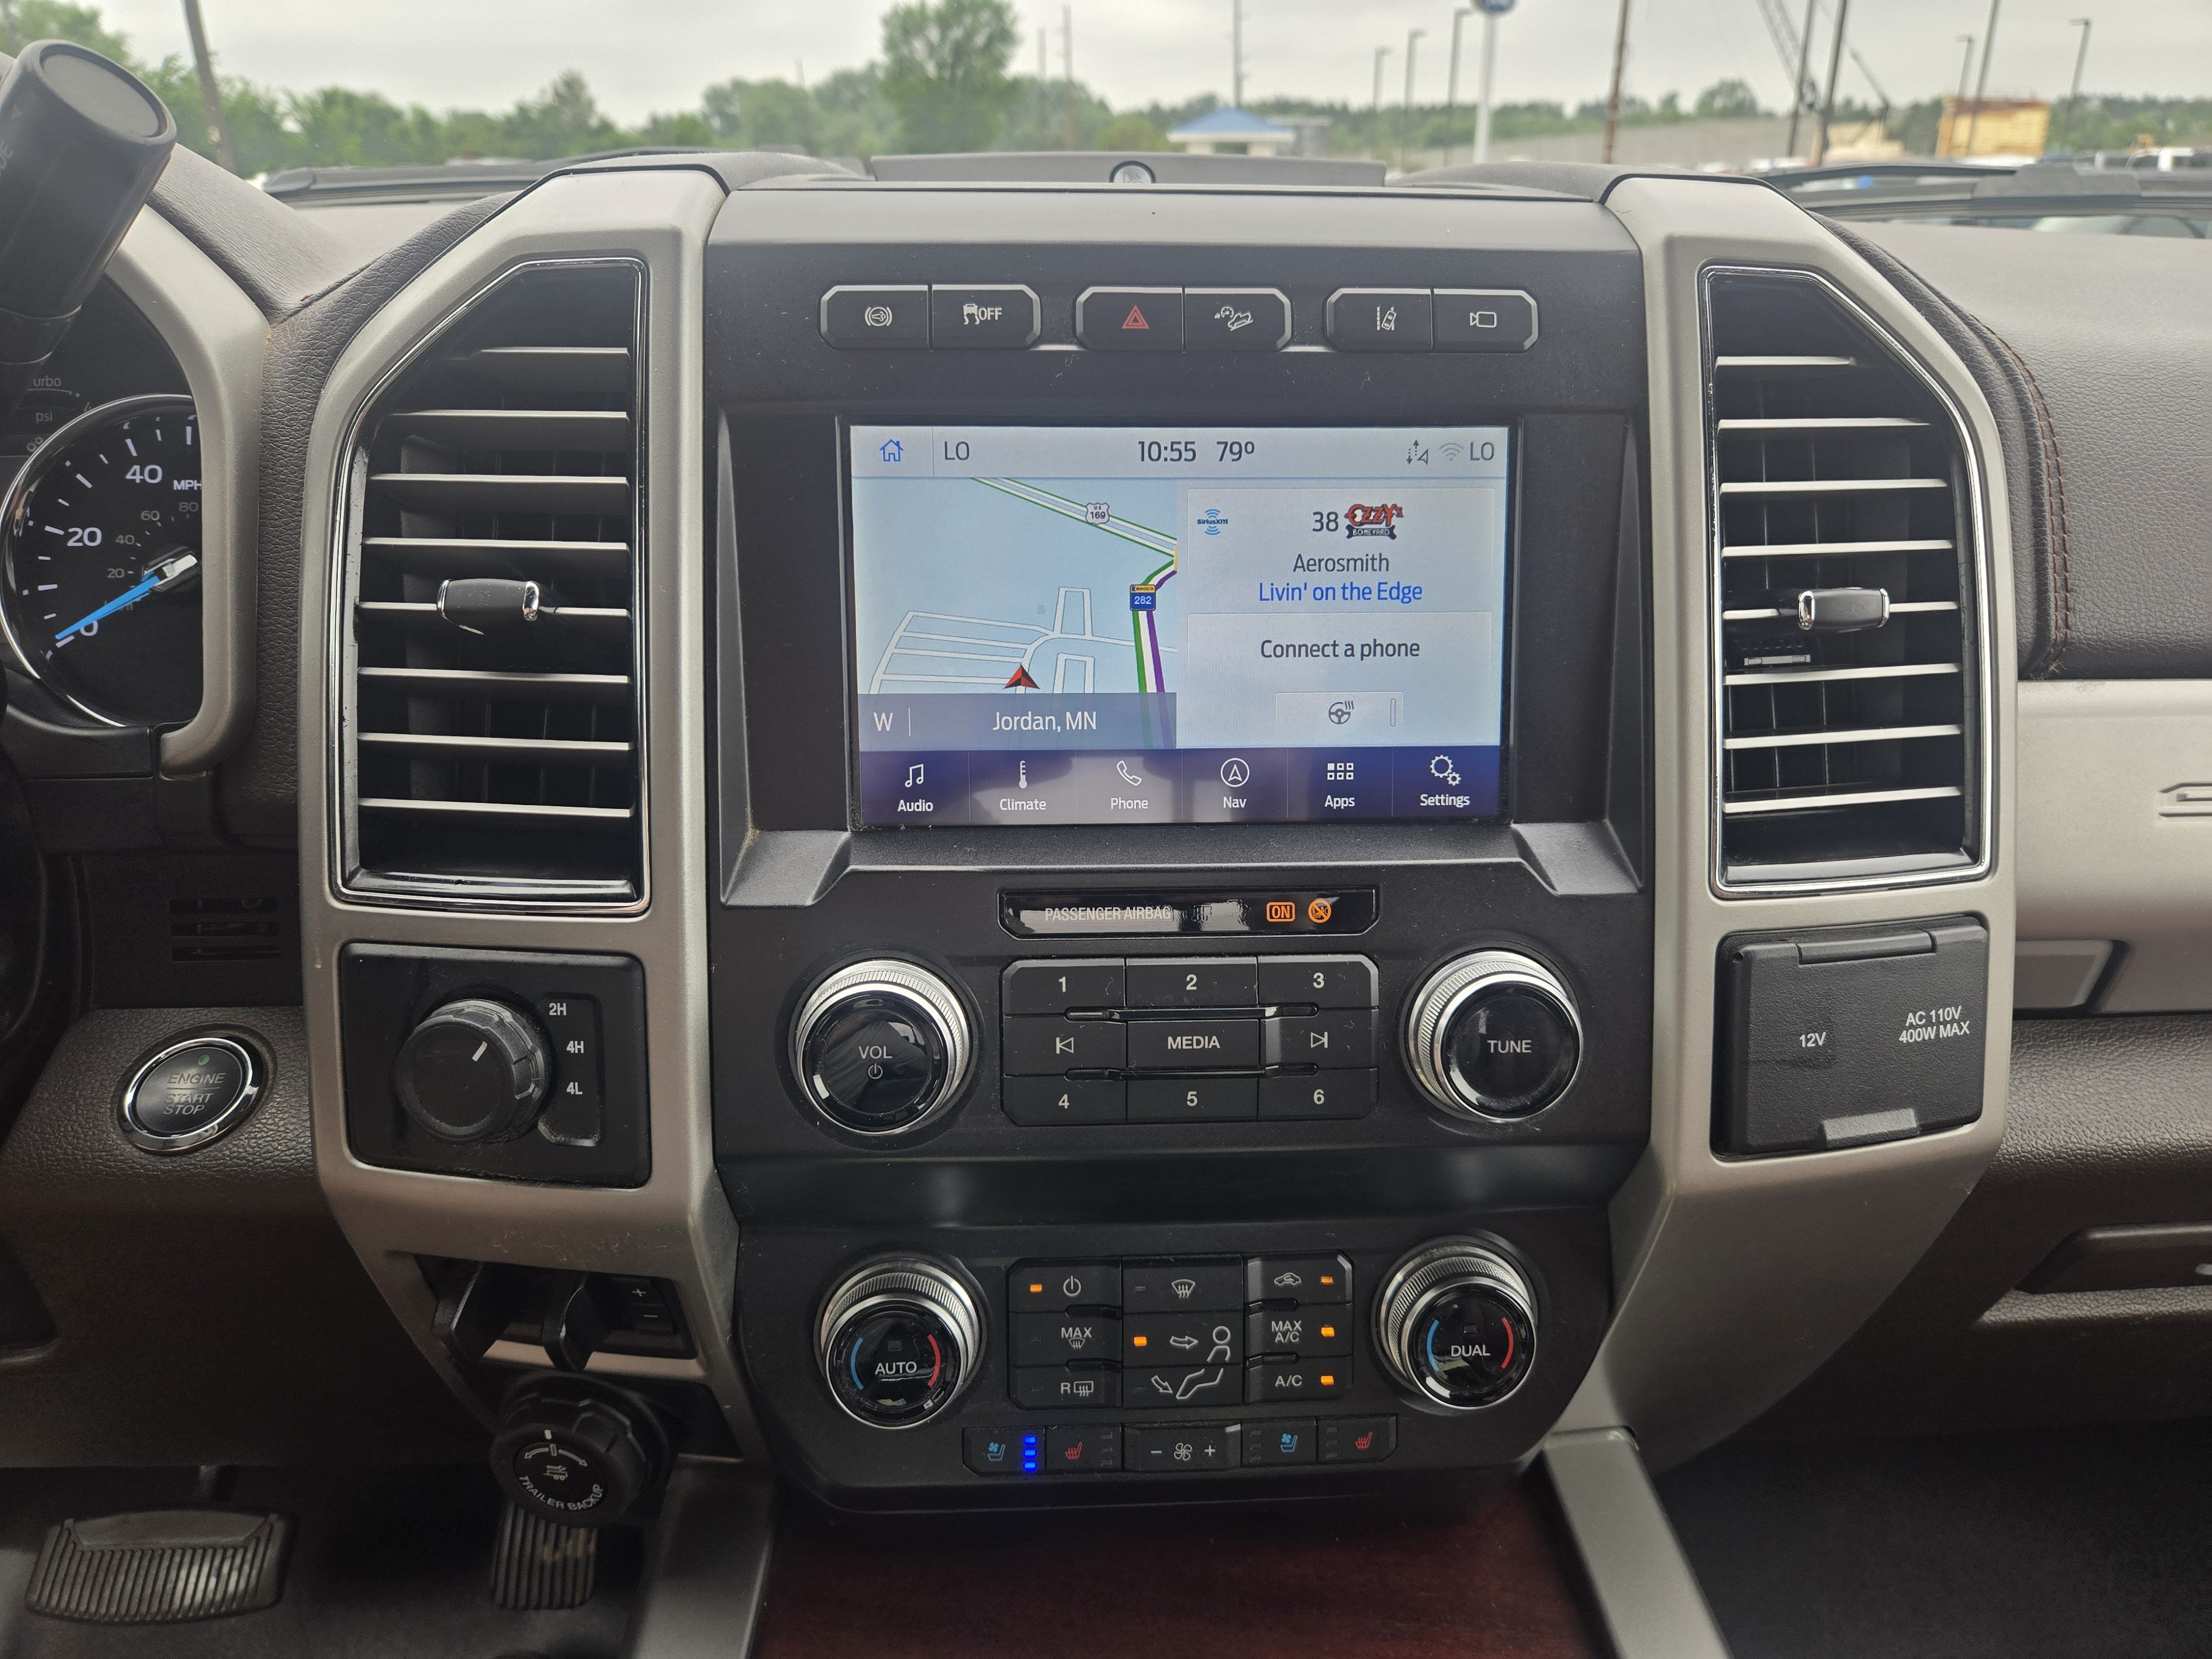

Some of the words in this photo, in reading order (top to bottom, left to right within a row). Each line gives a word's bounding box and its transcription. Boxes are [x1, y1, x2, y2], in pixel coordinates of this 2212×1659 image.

[979, 308, 1002, 321] OFF
[36, 411, 53, 423] psi
[945, 441, 970, 461] LO
[1138, 441, 1197, 462] 10:55
[1470, 442, 1494, 461] LO
[126, 465, 163, 484] 40
[173, 479, 202, 491] MPH
[179, 502, 198, 512] 80
[140, 510, 160, 521] 60
[1312, 512, 1339, 532] 38
[67, 526, 102, 547] 20
[115, 534, 135, 545] 40
[1293, 554, 1389, 572] Aerosmith
[107, 568, 125, 578] 20
[1259, 583, 1307, 601] Livin'
[1313, 586, 1335, 600] on
[1340, 583, 1371, 601] the
[1378, 582, 1422, 603] Edge
[1134, 596, 1152, 604] 282
[79, 620, 98, 637] 0
[1261, 640, 1338, 658] Connect
[1344, 643, 1355, 657] a
[1360, 639, 1420, 661] phone
[873, 712, 893, 732] W
[992, 711, 1061, 732] Jordan,
[1066, 712, 1097, 730] MN
[898, 800, 933, 812] Audio
[1000, 799, 1046, 811] Climate
[1111, 797, 1149, 810] Phone
[1223, 797, 1246, 808] Nav
[1324, 795, 1355, 807] Apps
[1420, 794, 1470, 807] Settings
[1045, 906, 1121, 922] PASSENGER
[1124, 905, 1172, 920] AIRBAG
[1272, 904, 1291, 919] ON
[1059, 977, 1067, 992] 1
[1186, 974, 1197, 990] 2
[1313, 973, 1324, 989] 3
[549, 1003, 567, 1016] 2H
[1905, 1011, 1926, 1027] AC
[1929, 1006, 1963, 1024] 110V
[1898, 1026, 1937, 1044] 400W
[1939, 1021, 1970, 1038] MAX
[1167, 1035, 1221, 1050] MEDIA
[1799, 1031, 1826, 1048] 12V
[566, 1041, 584, 1053] 4H
[858, 1045, 893, 1059] VOL
[1487, 1040, 1532, 1053] TUNE
[167, 1072, 226, 1084] ENGINE
[566, 1082, 583, 1095] 4L
[166, 1093, 214, 1104] START
[1058, 1094, 1070, 1109] 4
[1187, 1091, 1198, 1107] 5
[1313, 1089, 1324, 1104] 6
[163, 1105, 205, 1115] STOP
[1271, 1321, 1302, 1331] MAX
[1061, 1328, 1092, 1338] MAX
[1275, 1332, 1300, 1343] A/C
[1451, 1344, 1490, 1357] DUAL
[874, 1361, 917, 1375] AUTO
[1275, 1375, 1303, 1387] A/C
[1061, 1383, 1071, 1395] R
[519, 1475, 565, 1510] TRAILER
